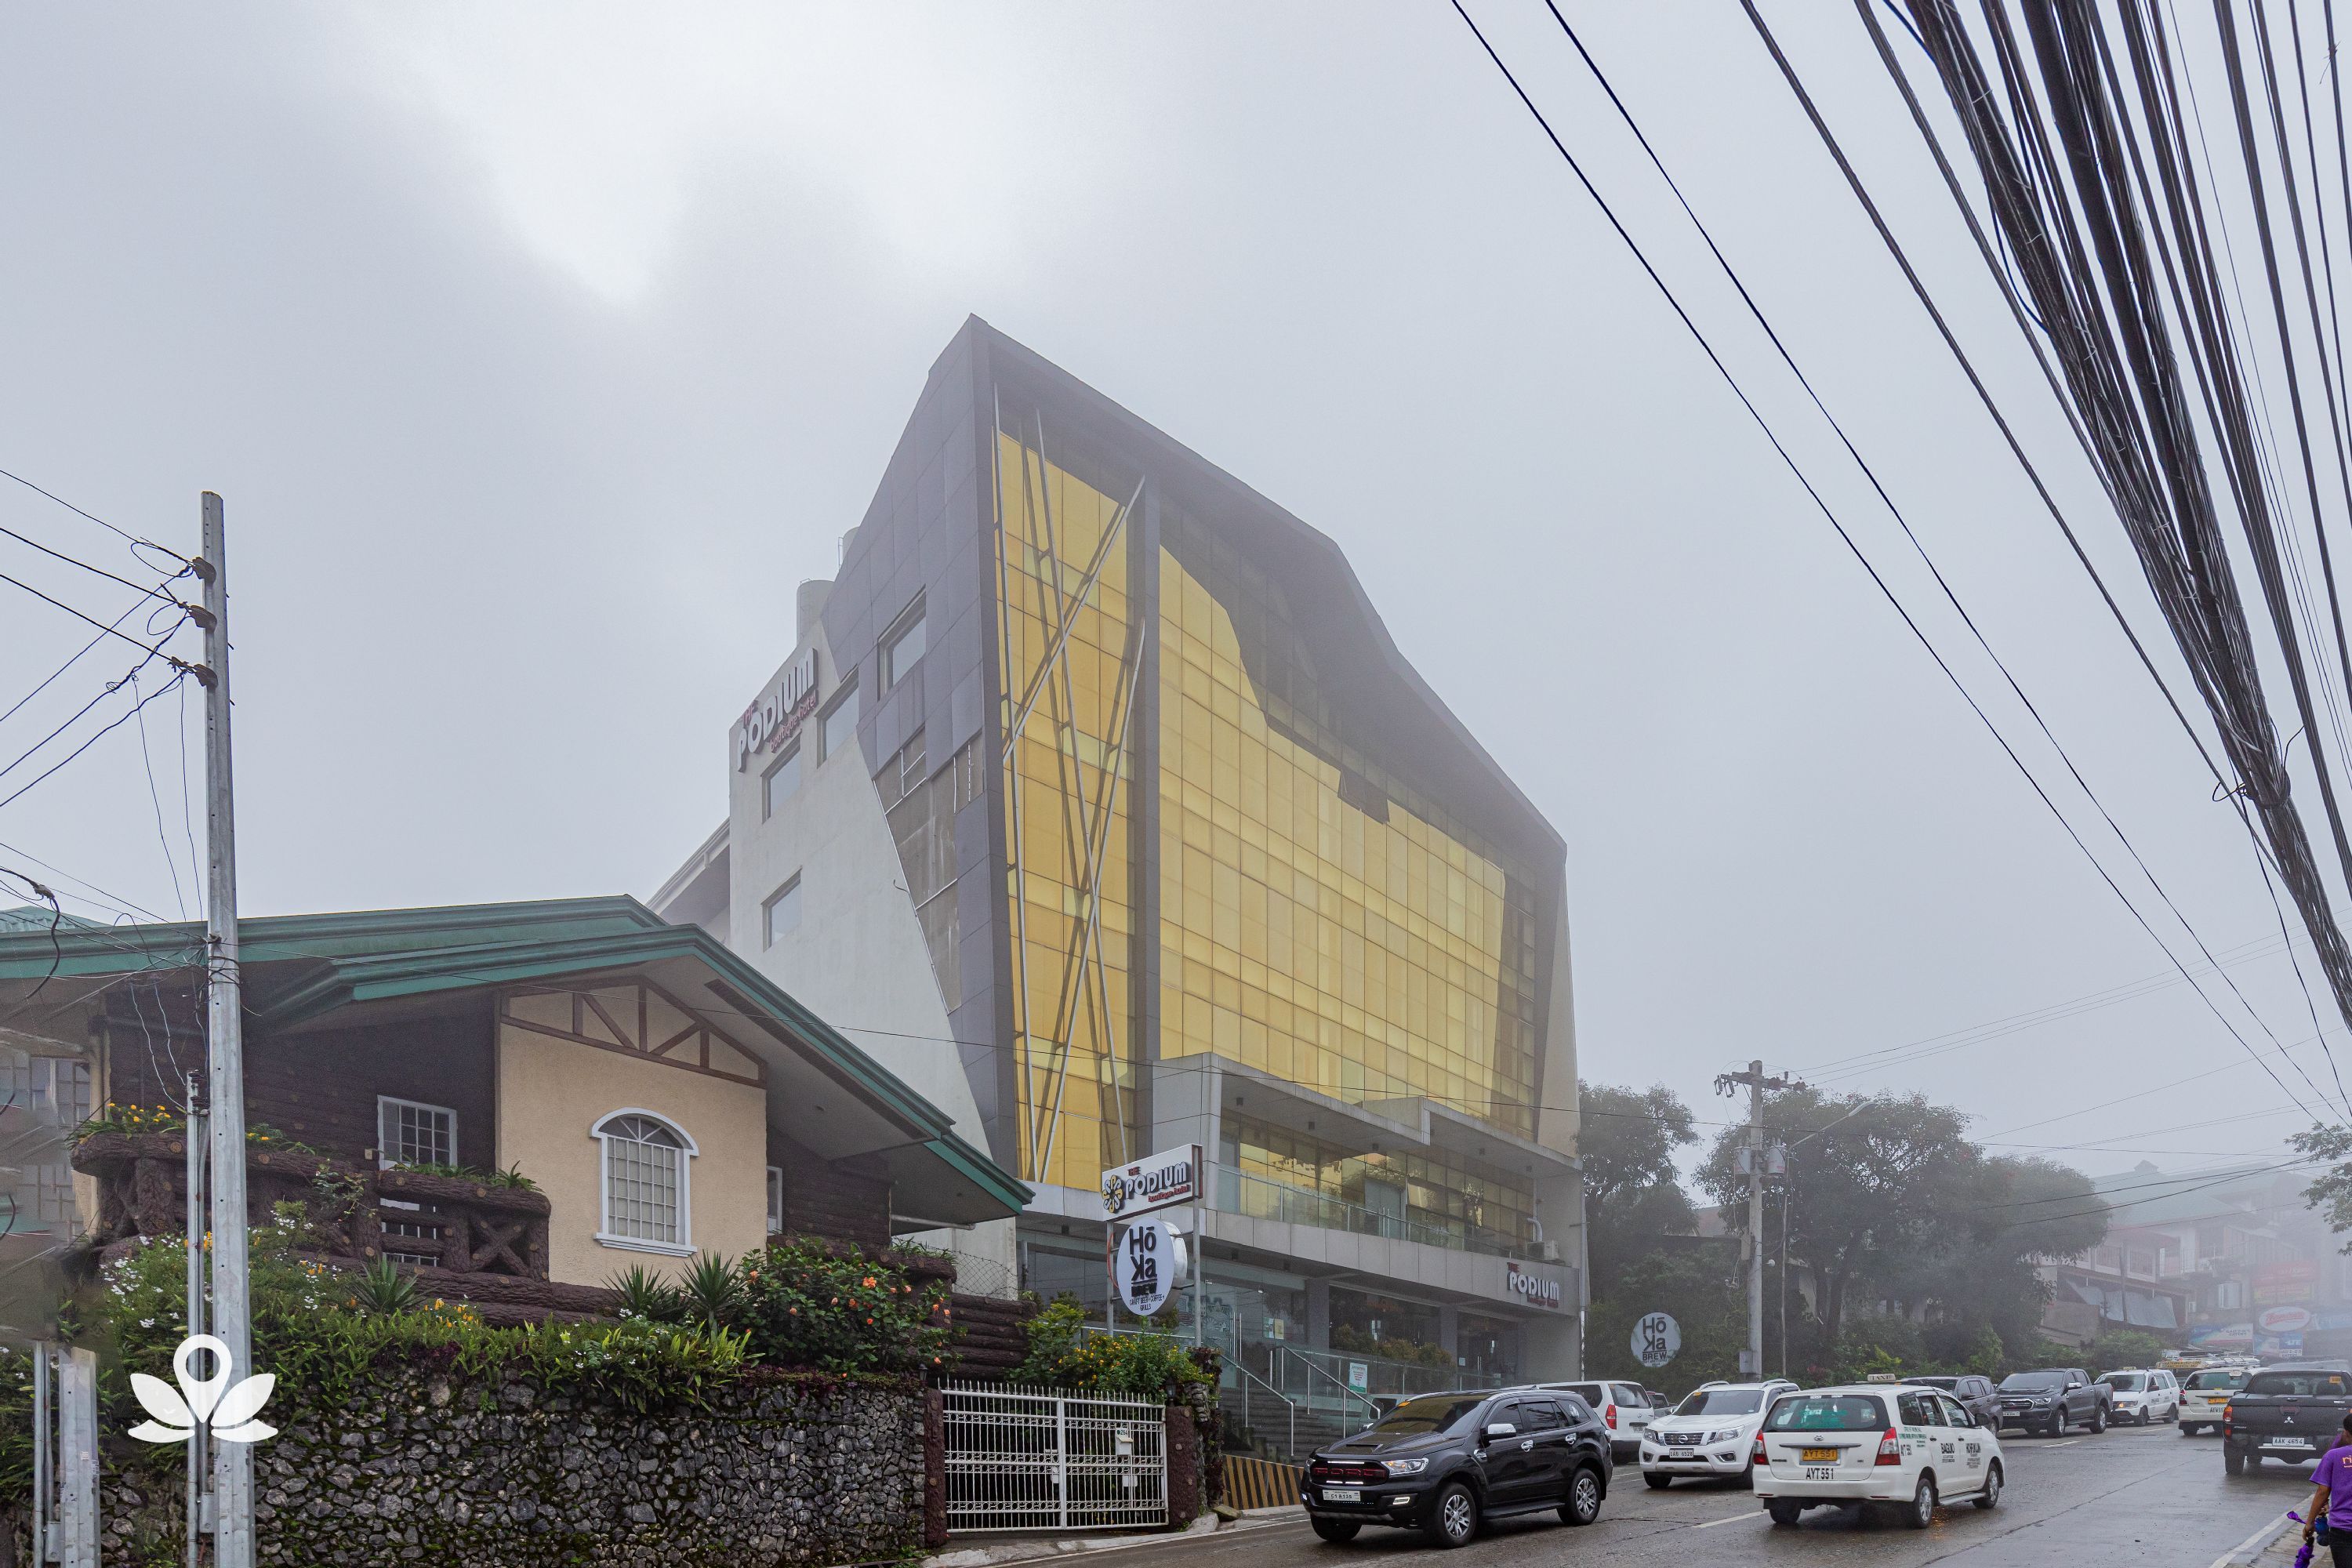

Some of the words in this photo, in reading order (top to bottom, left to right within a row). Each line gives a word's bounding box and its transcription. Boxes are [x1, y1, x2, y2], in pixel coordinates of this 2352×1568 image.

[770, 714, 800, 753] boutique
[799, 690, 818, 720] hotel
[1126, 1162, 1187, 1199] PODIUM
[1127, 1167, 1141, 1176] THE
[1131, 1283, 1157, 1297] BREW
[1508, 1272, 1559, 1301] PODIUM
